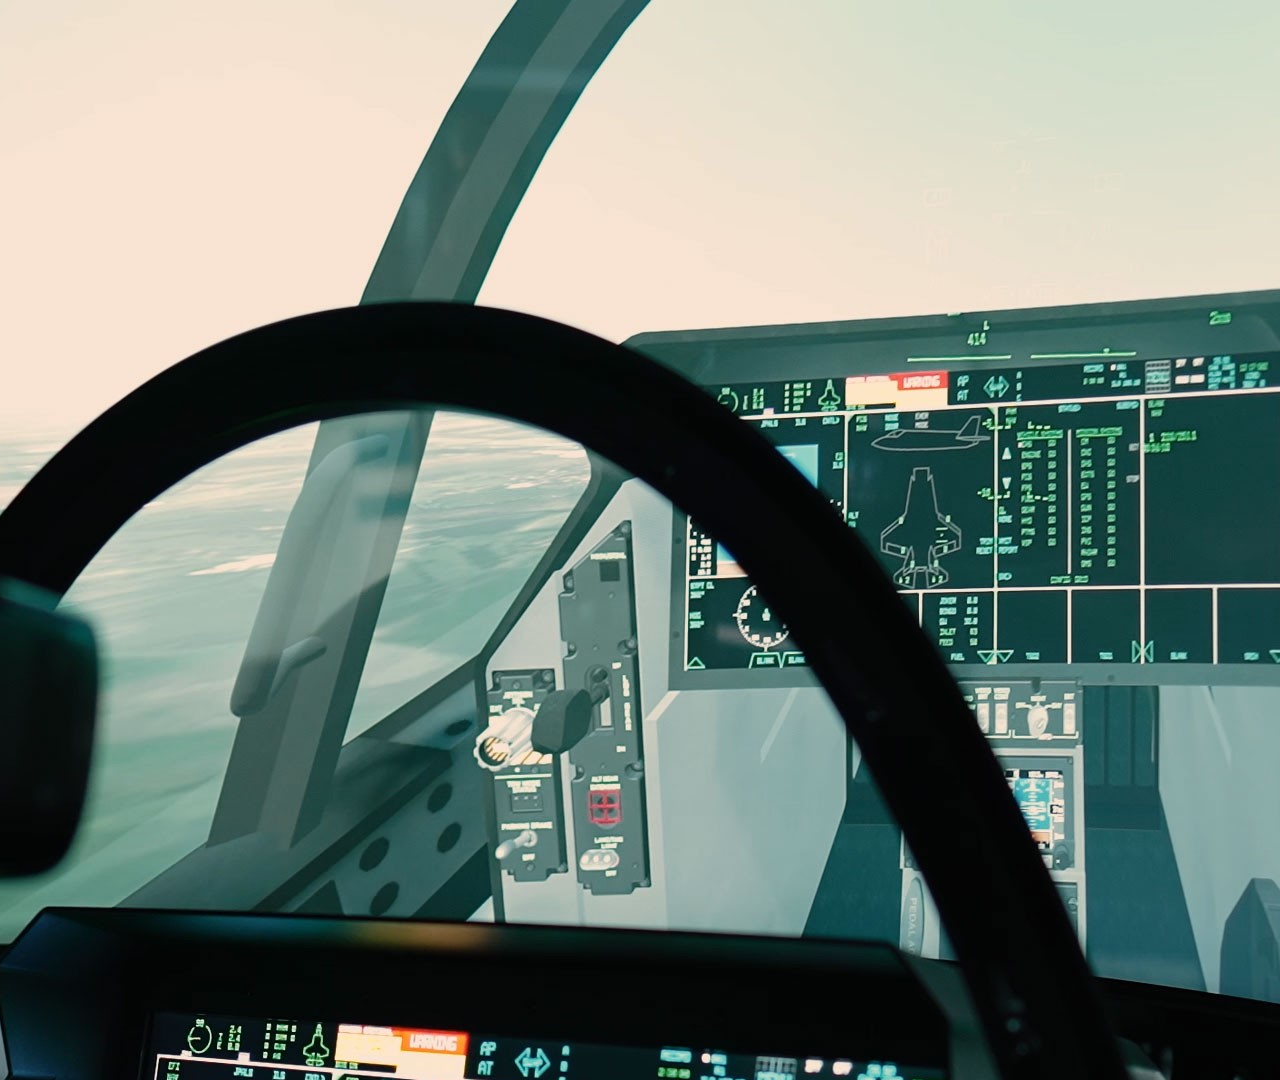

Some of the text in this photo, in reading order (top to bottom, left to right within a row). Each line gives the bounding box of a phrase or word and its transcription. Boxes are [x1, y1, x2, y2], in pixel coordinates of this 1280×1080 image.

[908, 897, 918, 937] PEDAL
[409, 1034, 458, 1052] WARNING
[480, 1041, 497, 1056] AP
[477, 1060, 494, 1076] AT
